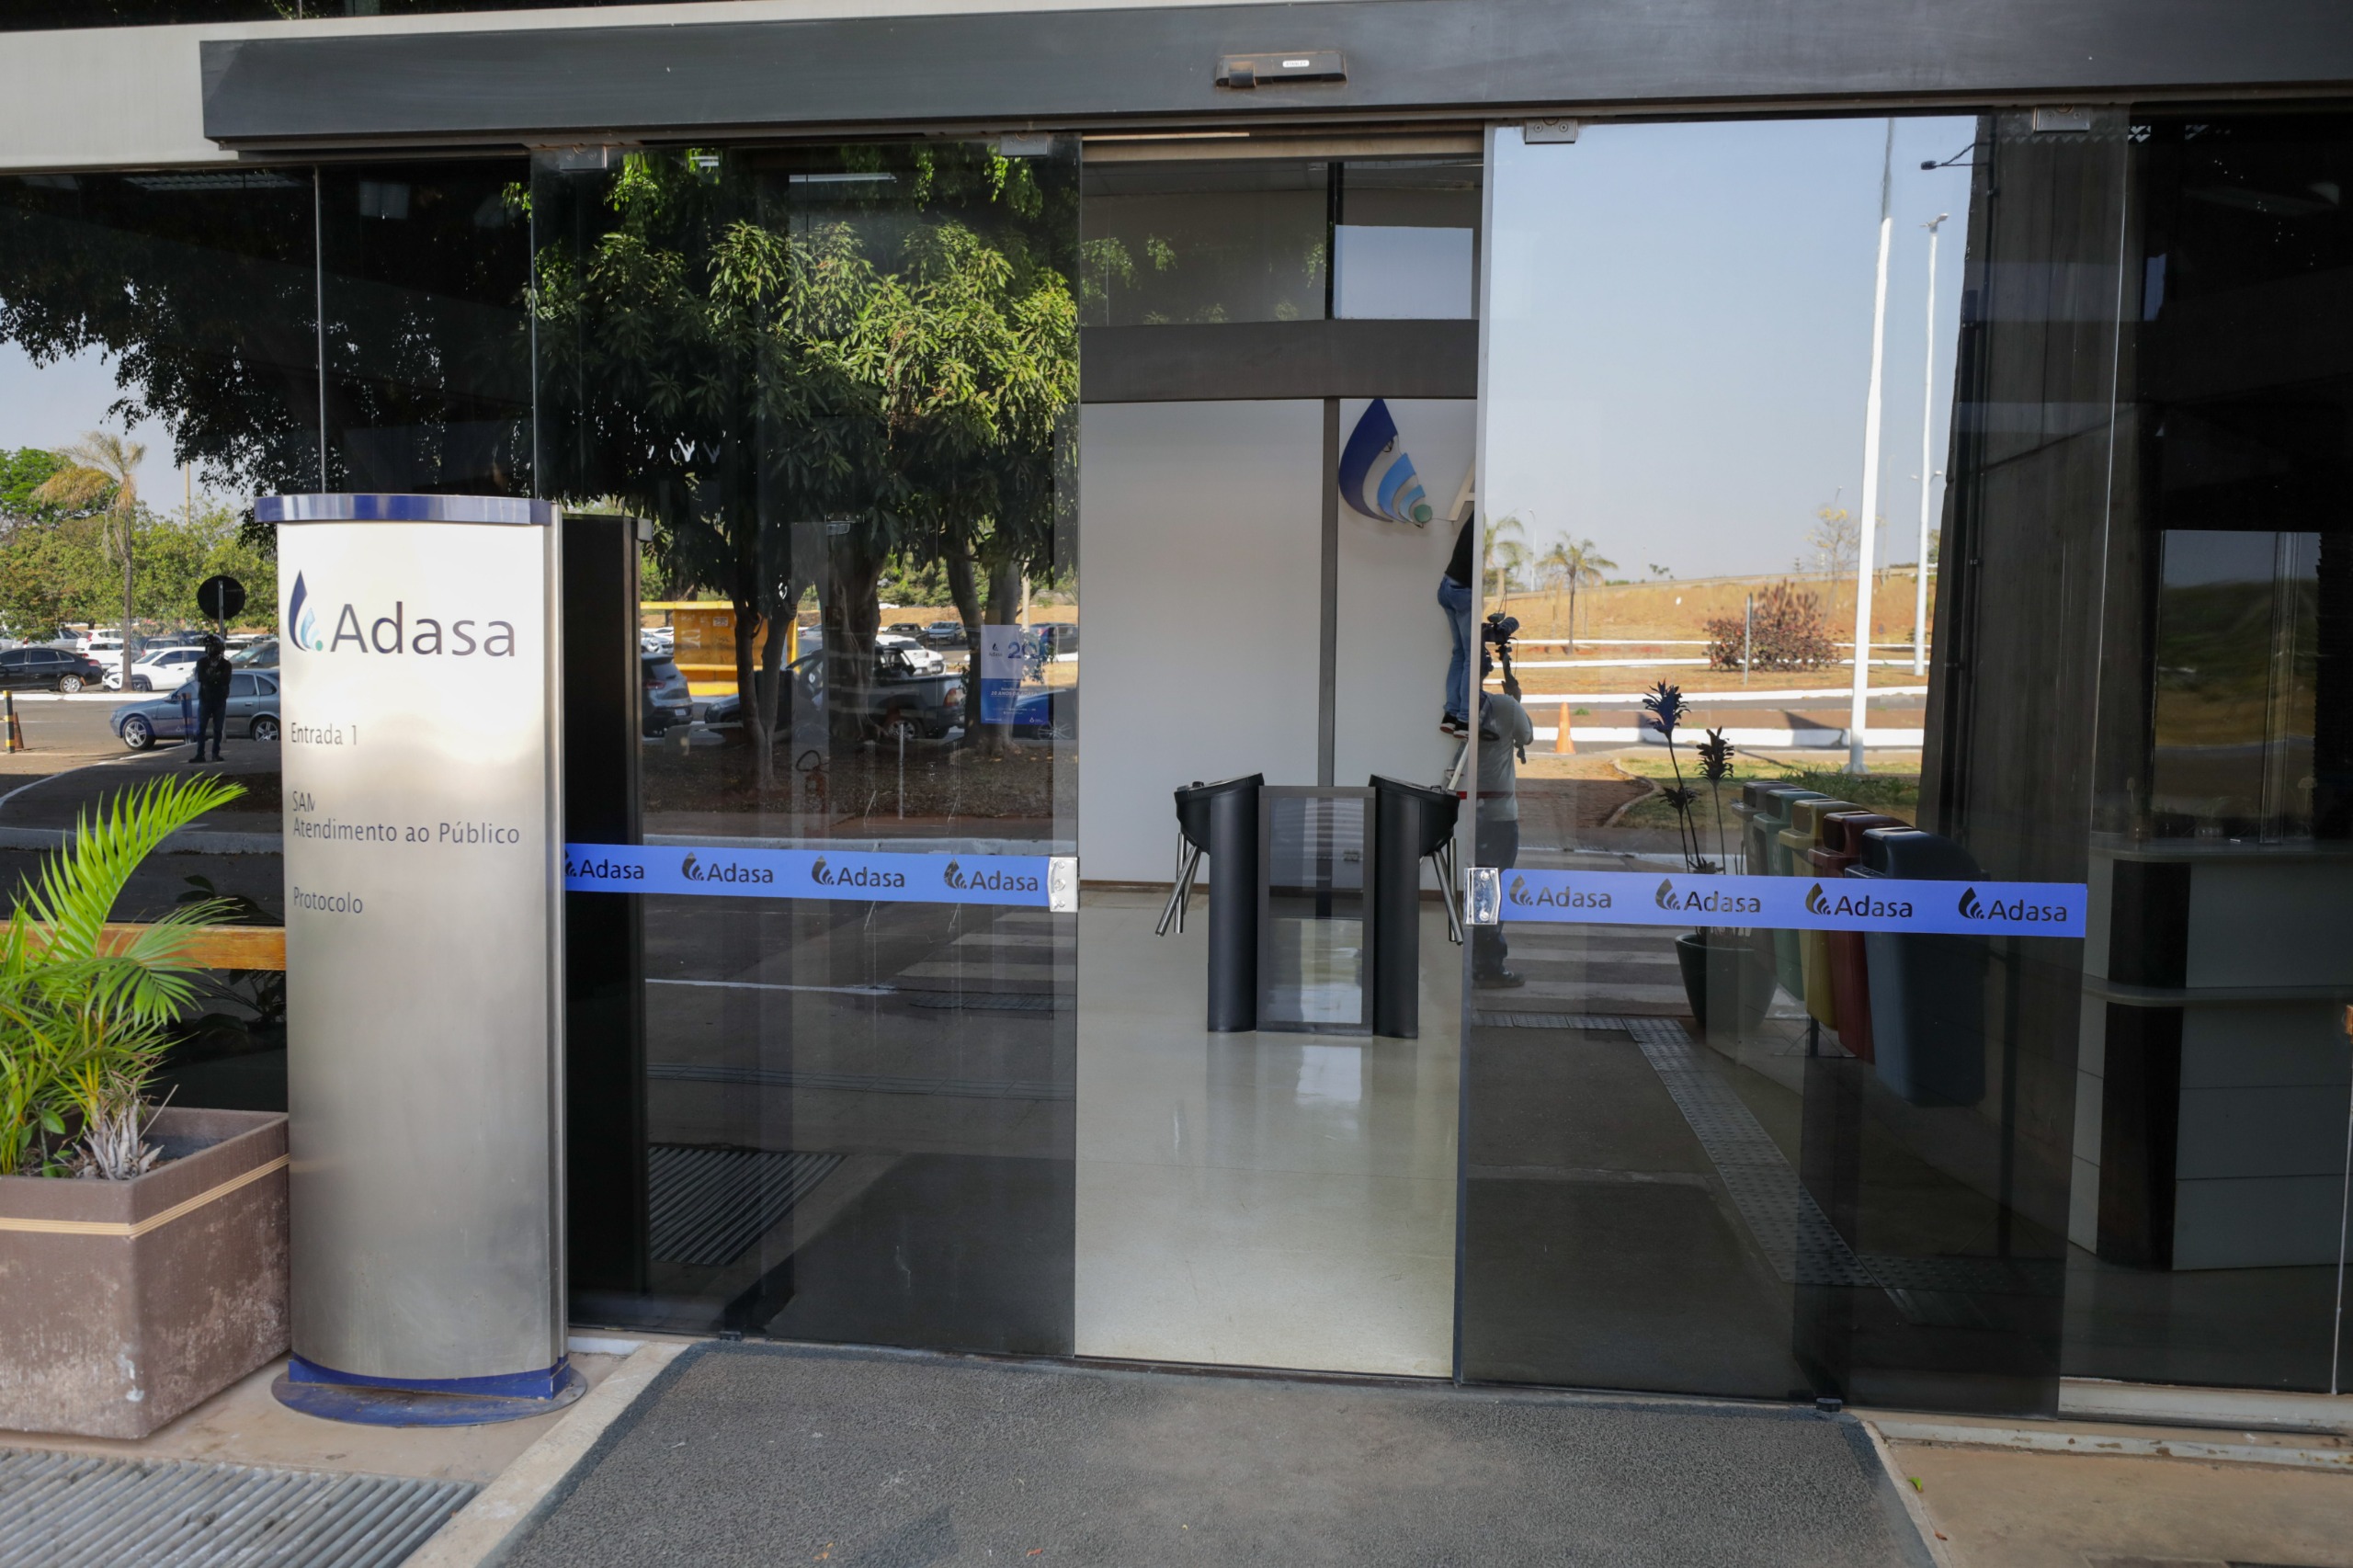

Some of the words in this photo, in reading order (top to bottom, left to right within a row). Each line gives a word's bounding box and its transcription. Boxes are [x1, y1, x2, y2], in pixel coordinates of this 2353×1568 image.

[330, 601, 515, 657] Adasa
[291, 722, 344, 745] Entrada
[351, 724, 358, 745] 1
[293, 817, 397, 842] Atendimento
[405, 826, 430, 843] ao
[439, 821, 520, 844] Público
[579, 858, 644, 880] Adasa
[707, 862, 774, 883] Adasa
[836, 867, 905, 889] Adasa
[969, 870, 1039, 892] Adasa
[293, 886, 363, 914] Protocolo
[1536, 886, 1612, 908] Adasa
[1683, 891, 1761, 913] Adasa
[1834, 895, 1913, 917] Adasa
[1987, 899, 2067, 922] Adasa
